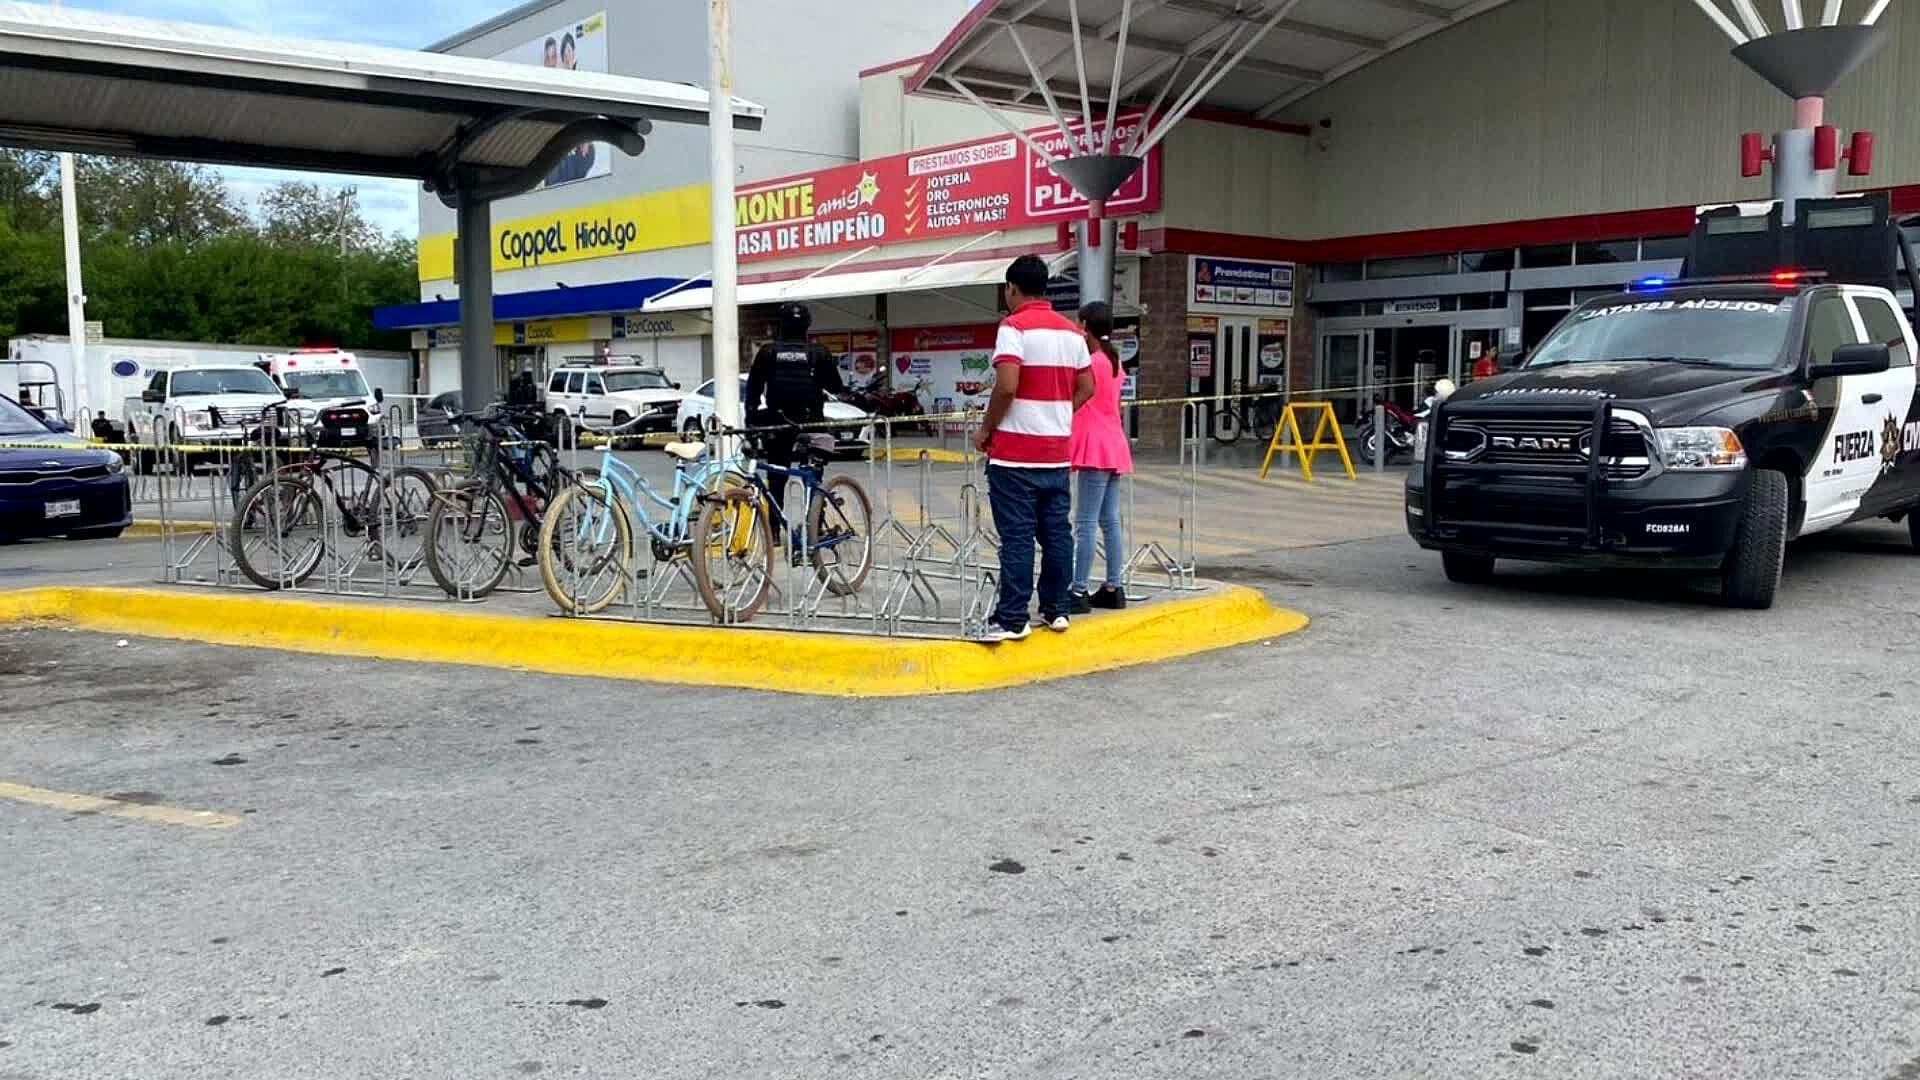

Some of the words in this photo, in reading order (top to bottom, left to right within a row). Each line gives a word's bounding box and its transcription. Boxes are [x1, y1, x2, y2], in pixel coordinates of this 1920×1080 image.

[912, 151, 970, 172] PRESTAMOS
[927, 172, 971, 189] JOYERIA
[735, 184, 815, 226] MONTE
[926, 189, 950, 202] ORO
[926, 193, 1010, 216] ELECTRONICOS
[926, 215, 960, 229] AUTOS
[964, 213, 973, 224] Y
[501, 220, 566, 267] Coppel
[575, 217, 636, 251] Hidalgo
[737, 230, 772, 255] ASA
[776, 226, 799, 251] DE
[803, 211, 885, 247] EMPEÑO
[1492, 436, 1570, 449] RAM
[1834, 430, 1874, 464] FUERZA
